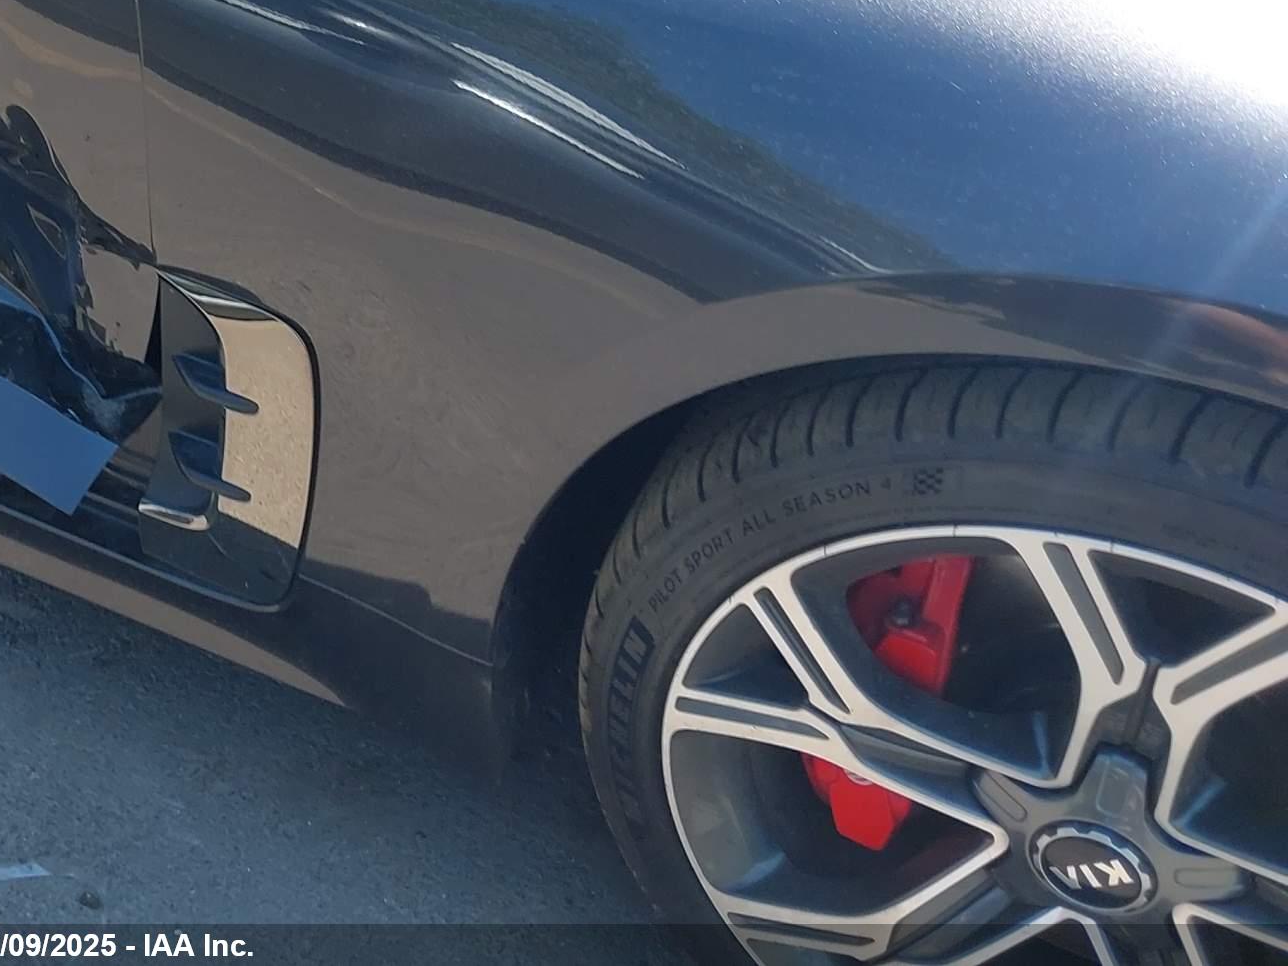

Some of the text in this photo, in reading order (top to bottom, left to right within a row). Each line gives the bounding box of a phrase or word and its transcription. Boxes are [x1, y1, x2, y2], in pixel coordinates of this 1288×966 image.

[647, 569, 684, 613] PILOT
[684, 529, 735, 575] SPORT
[741, 508, 777, 537] ALL
[781, 480, 872, 517] SEASON
[1048, 859, 1135, 890] KIA
